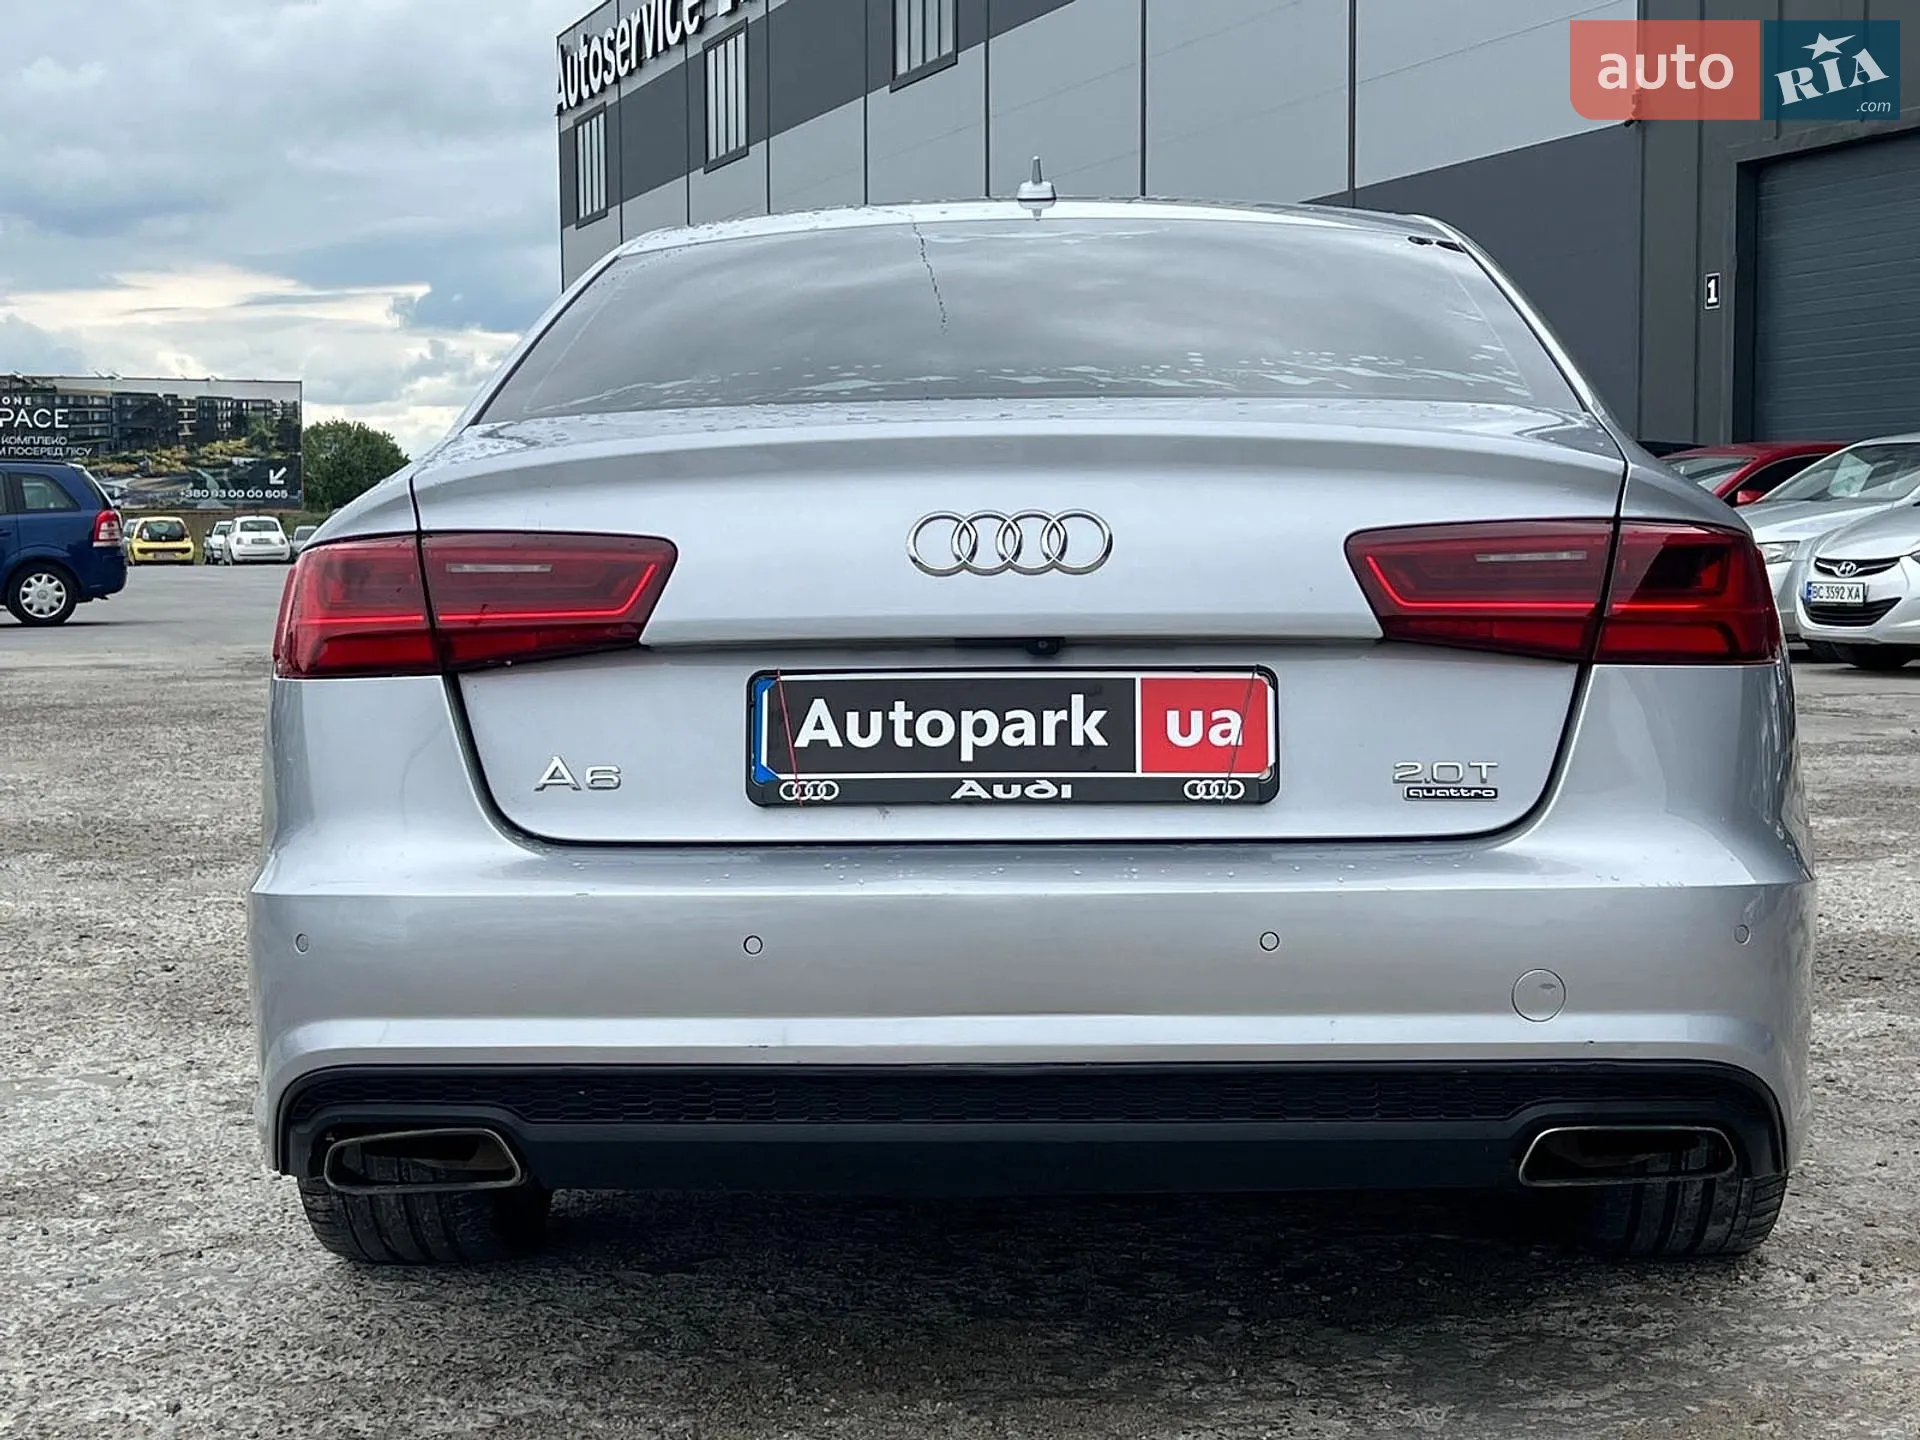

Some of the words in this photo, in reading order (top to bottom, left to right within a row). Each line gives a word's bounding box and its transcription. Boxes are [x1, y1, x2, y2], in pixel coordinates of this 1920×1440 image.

[556, 0, 700, 110] Autoservice
[1706, 278, 1718, 304] 1
[793, 693, 1109, 762] Autopark
[1165, 706, 1244, 748] ua
[534, 755, 621, 791] A6
[950, 779, 1073, 800] Audi
[1408, 788, 1496, 798] quattro
